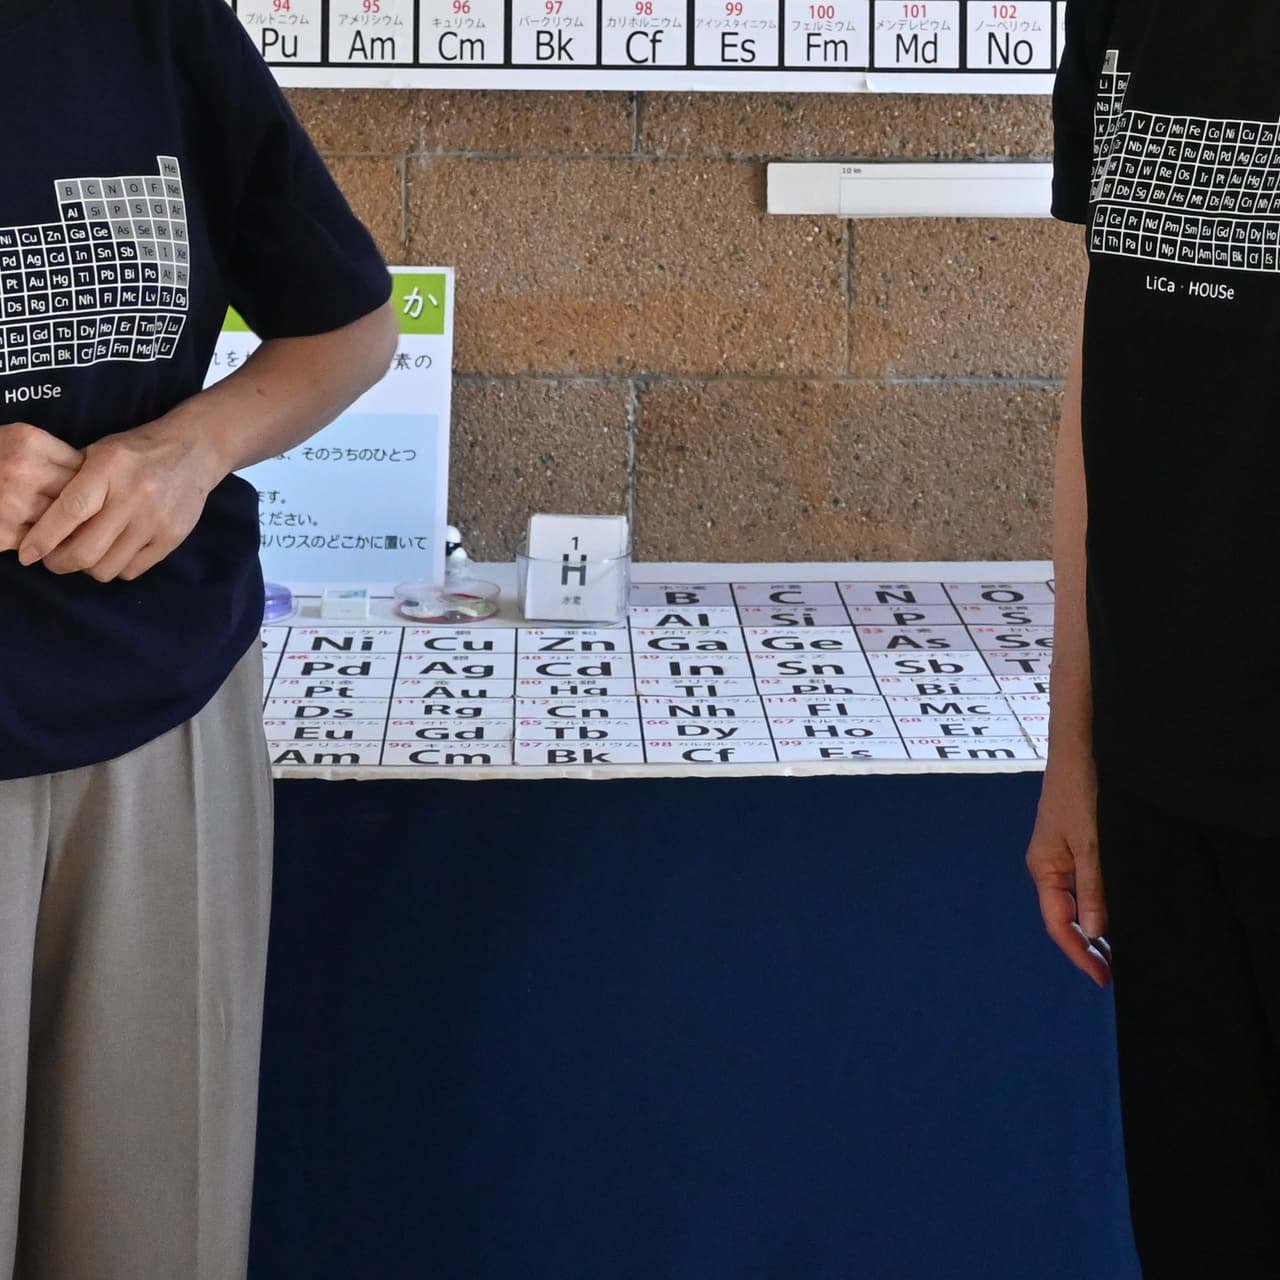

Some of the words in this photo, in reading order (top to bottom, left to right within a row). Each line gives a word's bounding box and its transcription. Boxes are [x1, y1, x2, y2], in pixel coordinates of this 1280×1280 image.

[993, 5, 1016, 19] 102
[896, 34, 937, 63] Md
[988, 33, 1032, 65] No
[22, 233, 37, 243] Cu
[97, 248, 111, 258] Sn
[27, 255, 41, 266] Ag
[30, 277, 44, 287] Au
[1147, 276, 1175, 292] LiCa
[1189, 282, 1234, 299] HOUSe
[403, 286, 438, 318] か
[5, 384, 61, 403] HOUSe
[572, 537, 578, 550] 1
[562, 554, 587, 585] H
[312, 637, 372, 650] Ni
[424, 637, 493, 651] Cu
[539, 638, 615, 651] Zn
[648, 637, 727, 650] Ga
[762, 637, 842, 650] Ge
[536, 662, 611, 676] Cd
[409, 750, 490, 764] Cm
[545, 748, 611, 764] Bk
